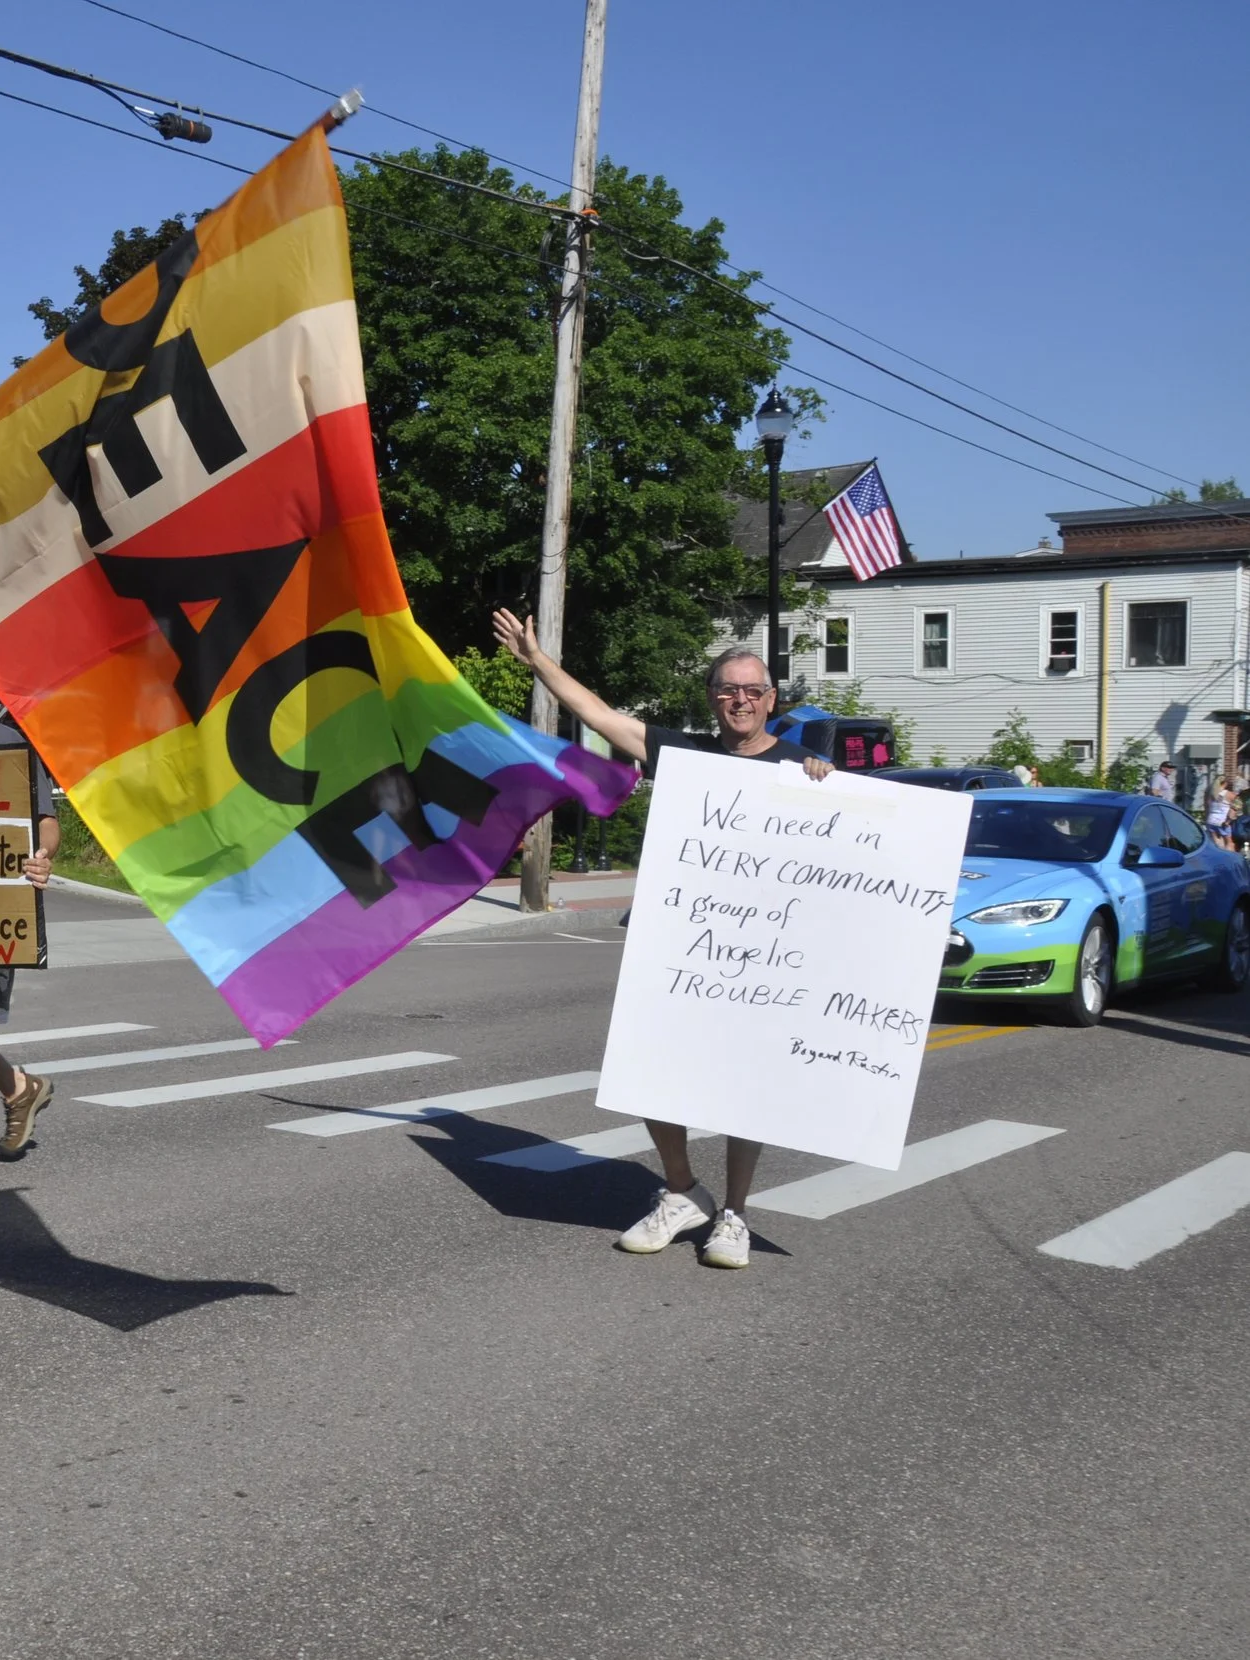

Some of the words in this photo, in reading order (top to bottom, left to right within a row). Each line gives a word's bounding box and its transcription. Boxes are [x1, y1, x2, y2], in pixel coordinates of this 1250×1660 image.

[703, 789, 747, 832] We
[764, 812, 841, 839] need
[856, 829, 881, 850] in
[678, 838, 771, 878] EVERY
[664, 887, 681, 908] a
[691, 895, 758, 929] group
[767, 898, 801, 930] of
[686, 929, 804, 979] Angelic
[665, 966, 809, 1007] TROUBLE
[824, 991, 924, 1046] MAKERS
